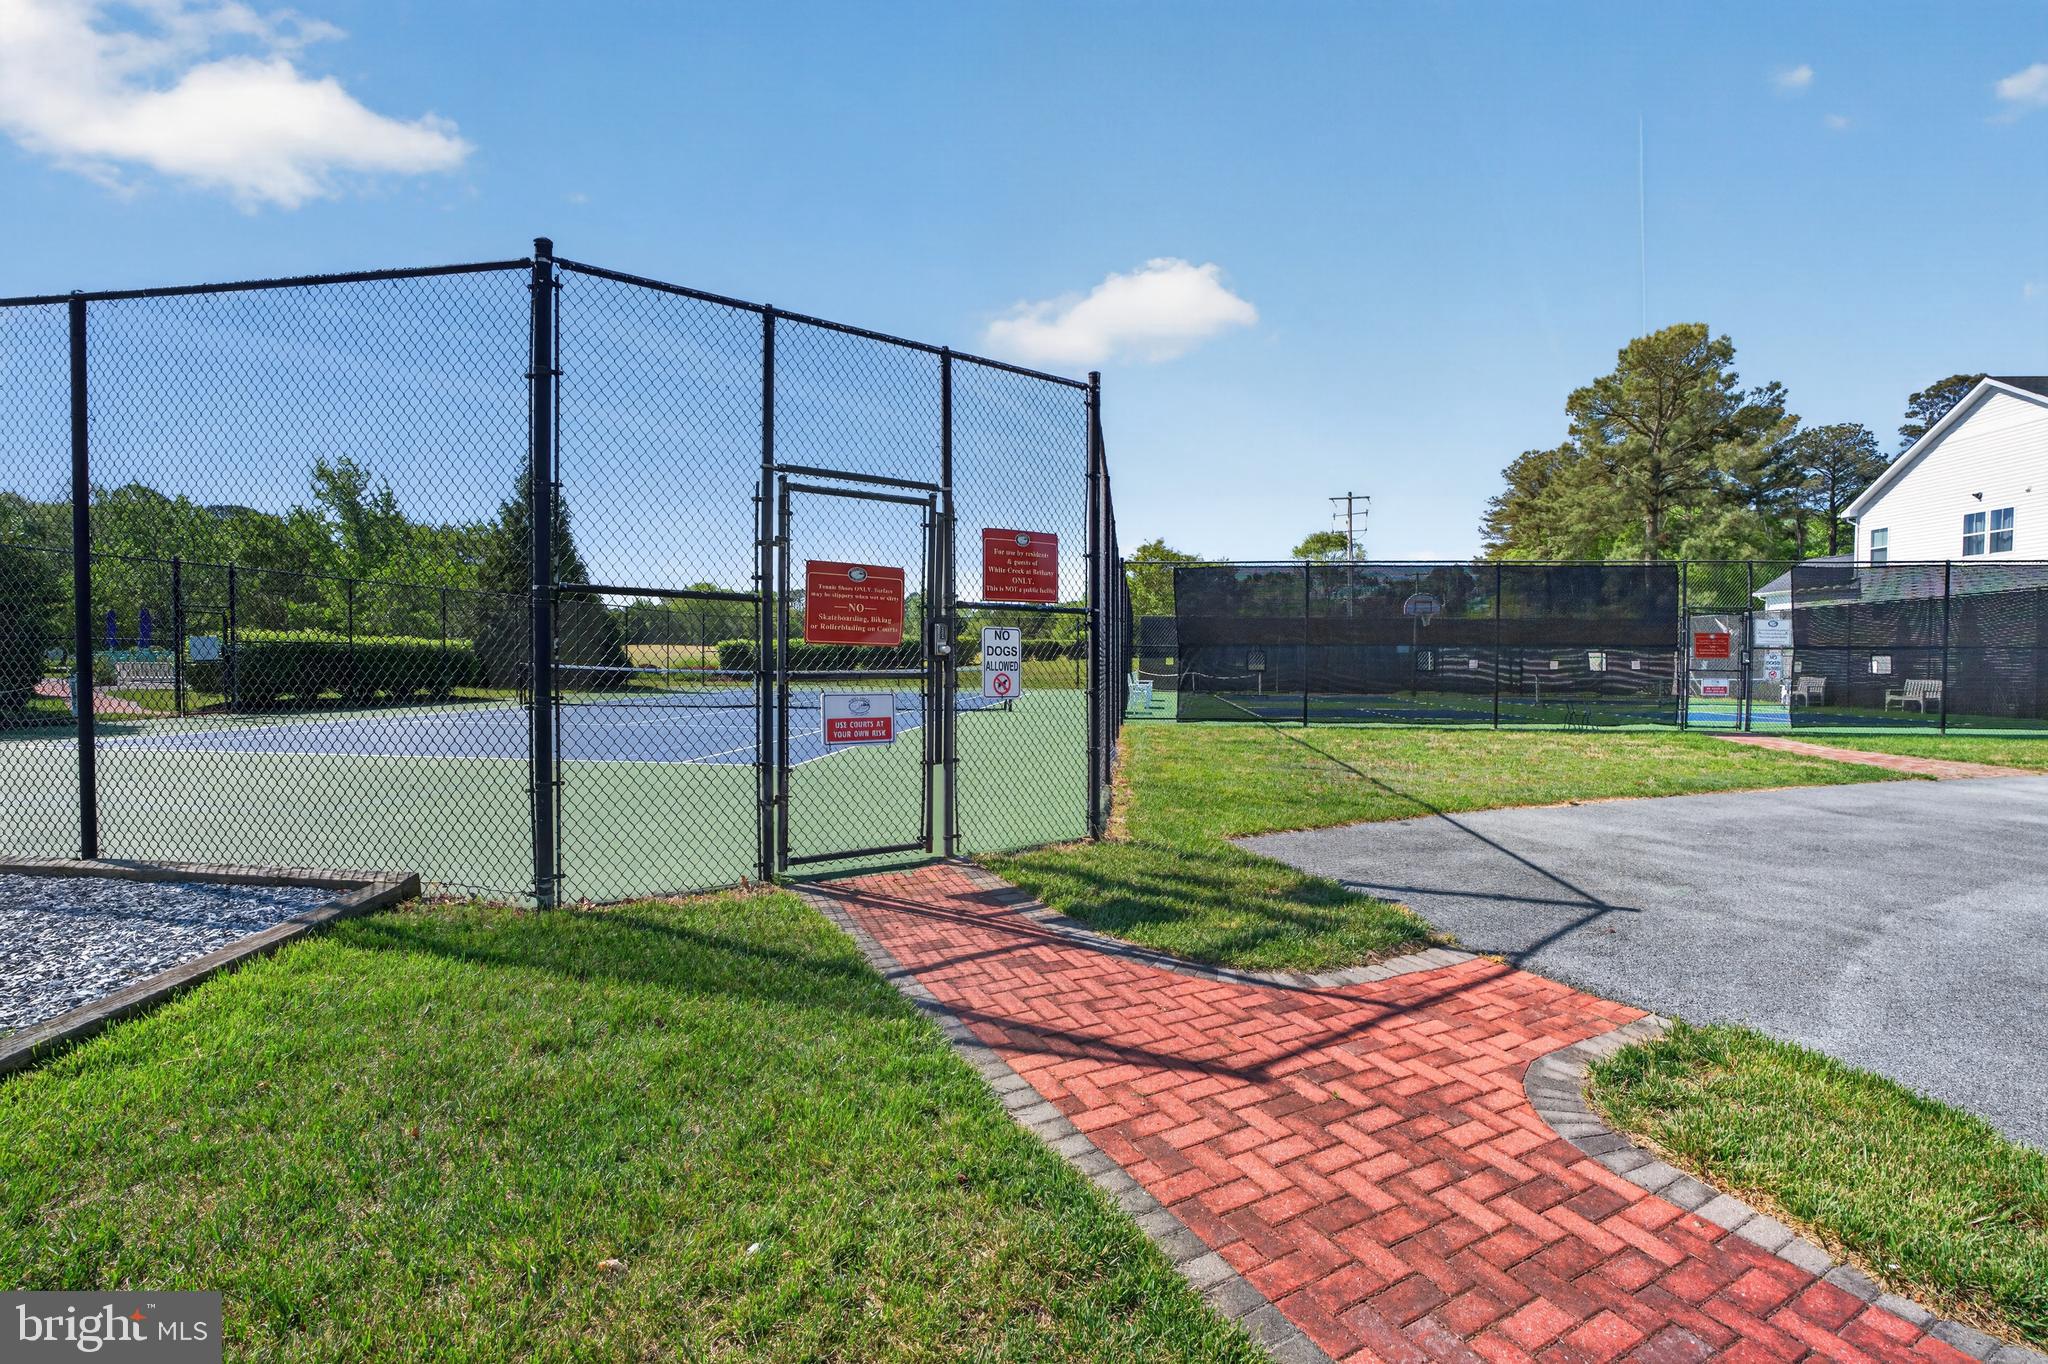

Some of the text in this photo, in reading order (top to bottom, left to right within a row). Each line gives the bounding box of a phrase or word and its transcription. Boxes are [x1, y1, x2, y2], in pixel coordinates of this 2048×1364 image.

[988, 566, 1006, 574] White
[1007, 567, 1024, 575] Creek
[1033, 569, 1054, 577] Bethany
[848, 603, 864, 612] NO
[818, 613, 892, 624] Skateboarding, Biking
[820, 623, 866, 632] Rollerblading
[994, 630, 1010, 641] NO
[986, 645, 1018, 657] DOGS
[986, 660, 1019, 672] ALLOWED
[834, 721, 847, 729] USE
[849, 720, 874, 729] COURTS
[833, 729, 886, 738] YOUR OWN RISK
